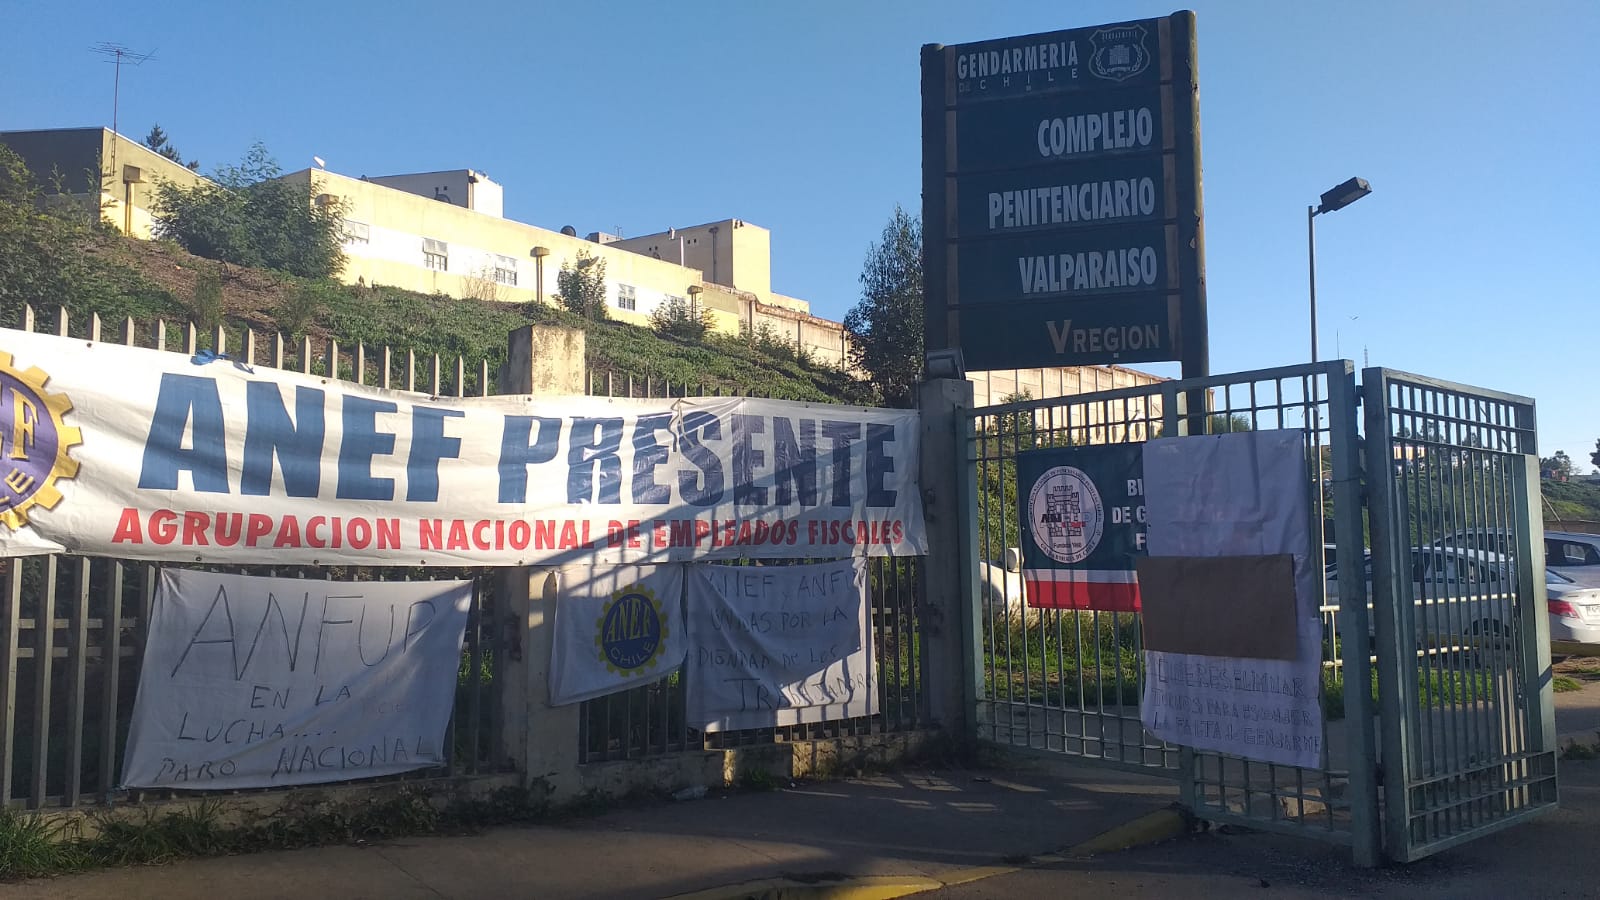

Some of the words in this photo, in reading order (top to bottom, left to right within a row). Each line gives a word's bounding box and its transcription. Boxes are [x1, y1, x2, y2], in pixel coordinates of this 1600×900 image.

[957, 40, 1079, 80] GENDARMERIA
[1037, 107, 1153, 157] COMPLEJO
[988, 176, 1155, 230] PENITENCIARIO
[1018, 246, 1158, 294] VALPARAISO
[138, 372, 466, 502] ANEF
[497, 410, 898, 508] PRESENTE
[112, 508, 401, 550] AGRUPACION
[419, 518, 595, 551] NACIONAL
[607, 519, 641, 549] DE
[654, 518, 799, 549] EMPLEADOS
[808, 519, 904, 546] FISCALES
[1111, 506, 1133, 524] DE
[171, 584, 436, 681] ANFUP
[605, 598, 651, 643] ANEF
[781, 610, 811, 632] POR
[823, 605, 848, 627] LA
[250, 685, 290, 709] EN
[315, 685, 352, 707] LA
[271, 736, 436, 779] NACIONAL
